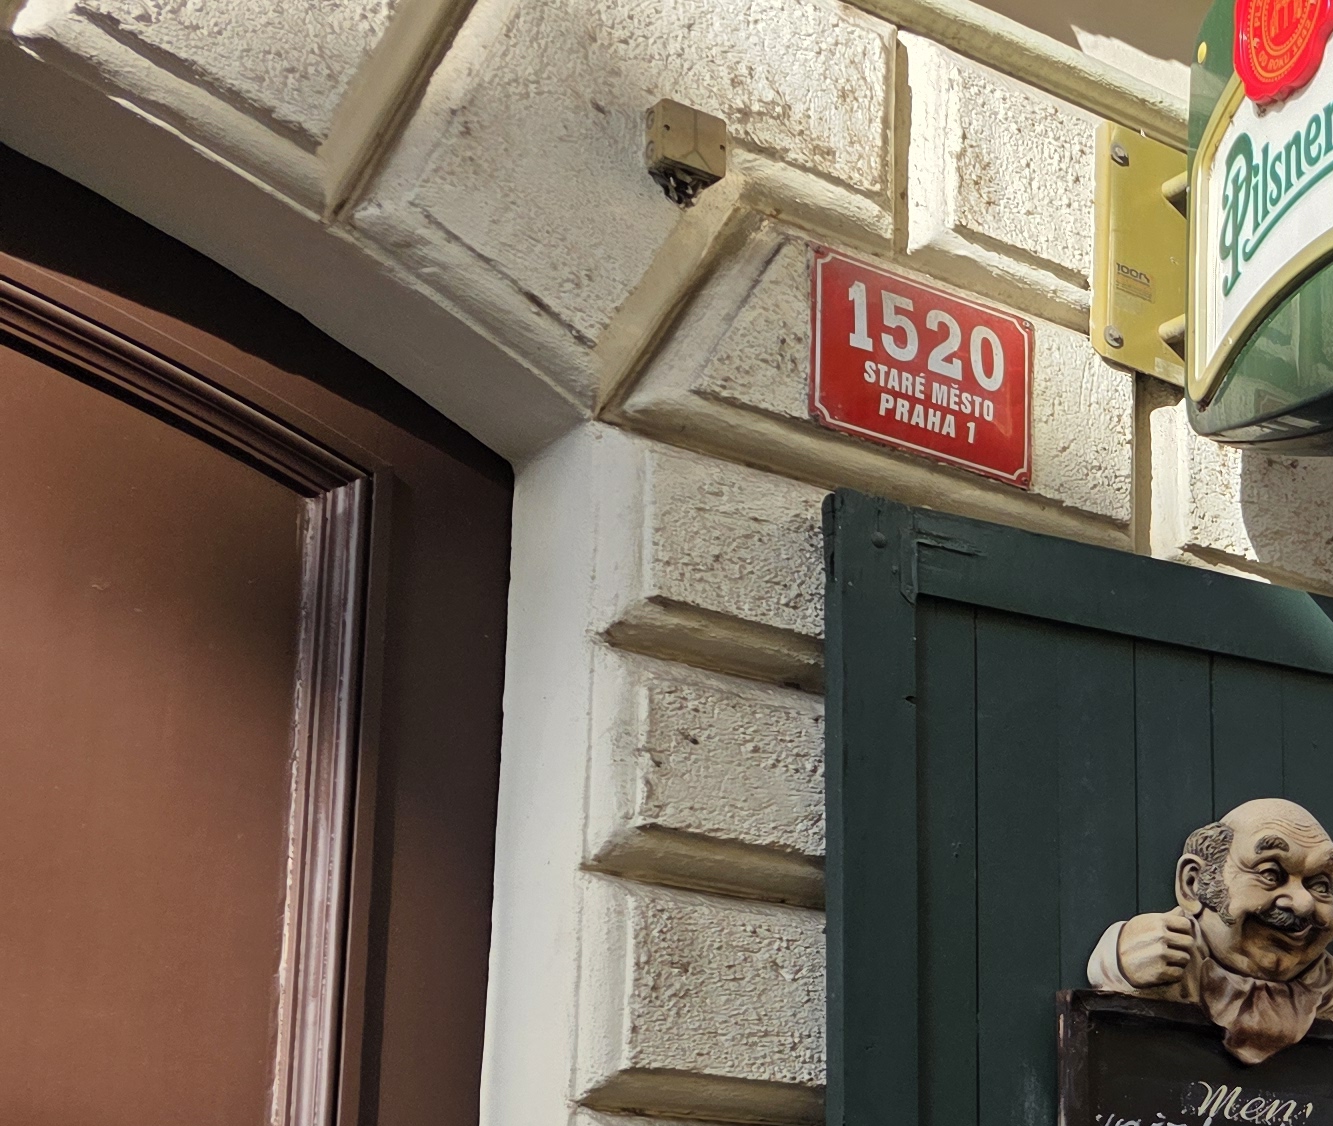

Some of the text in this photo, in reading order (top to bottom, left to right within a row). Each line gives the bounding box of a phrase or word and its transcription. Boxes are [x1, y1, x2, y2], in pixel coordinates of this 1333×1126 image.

[848, 280, 1004, 392] 1520
[863, 360, 994, 422] STARÉ MĚSTO
[878, 392, 976, 444] PRAHA 1
